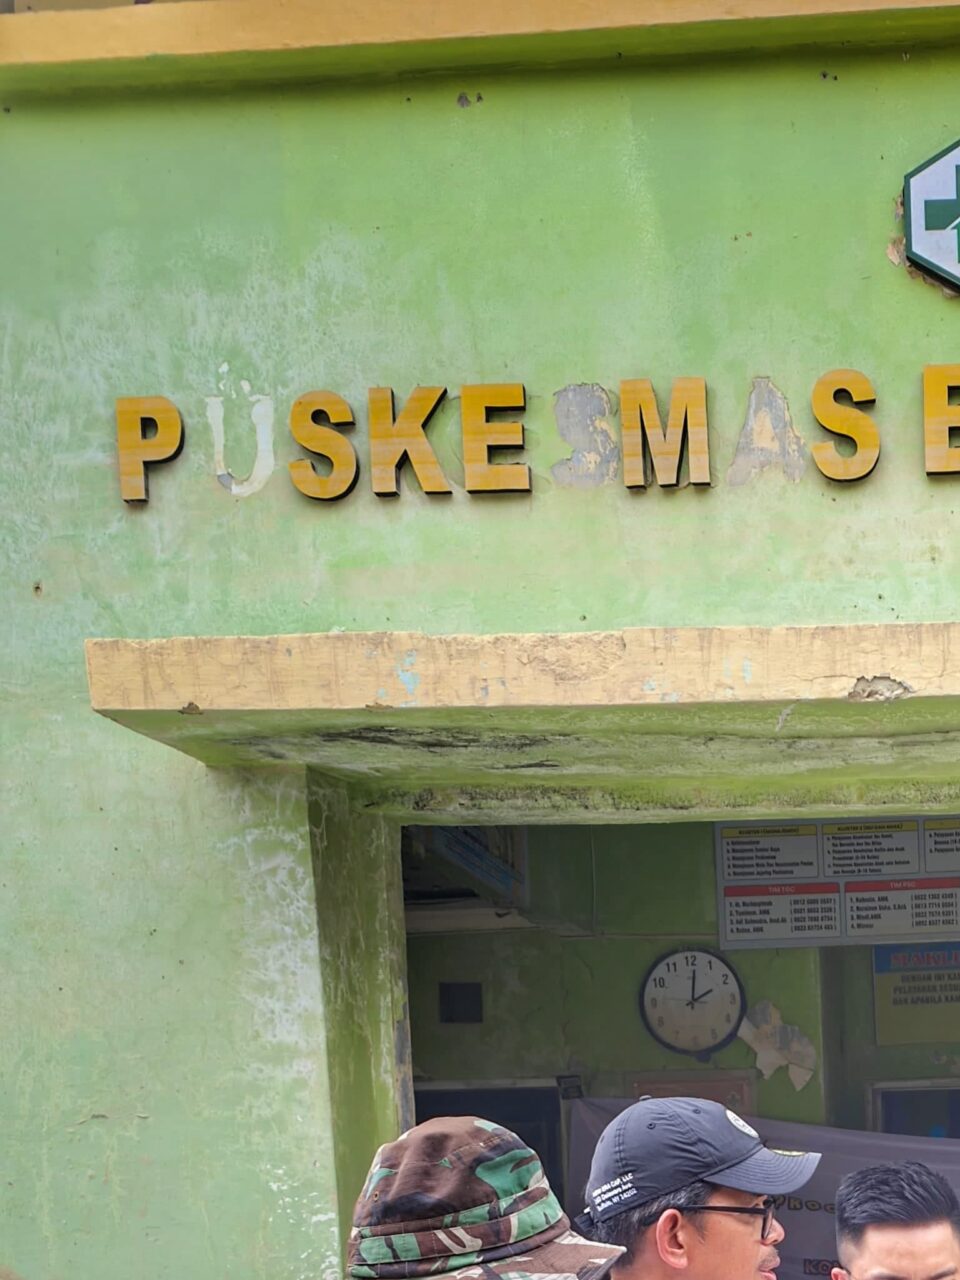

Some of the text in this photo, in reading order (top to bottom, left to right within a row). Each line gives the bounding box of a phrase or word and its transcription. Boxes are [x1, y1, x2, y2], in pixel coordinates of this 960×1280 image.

[685, 955, 697, 967] 12
[707, 960, 713, 971] 1
[665, 962, 678, 974] 11
[653, 977, 665, 989] 10
[722, 974, 729, 985] 2
